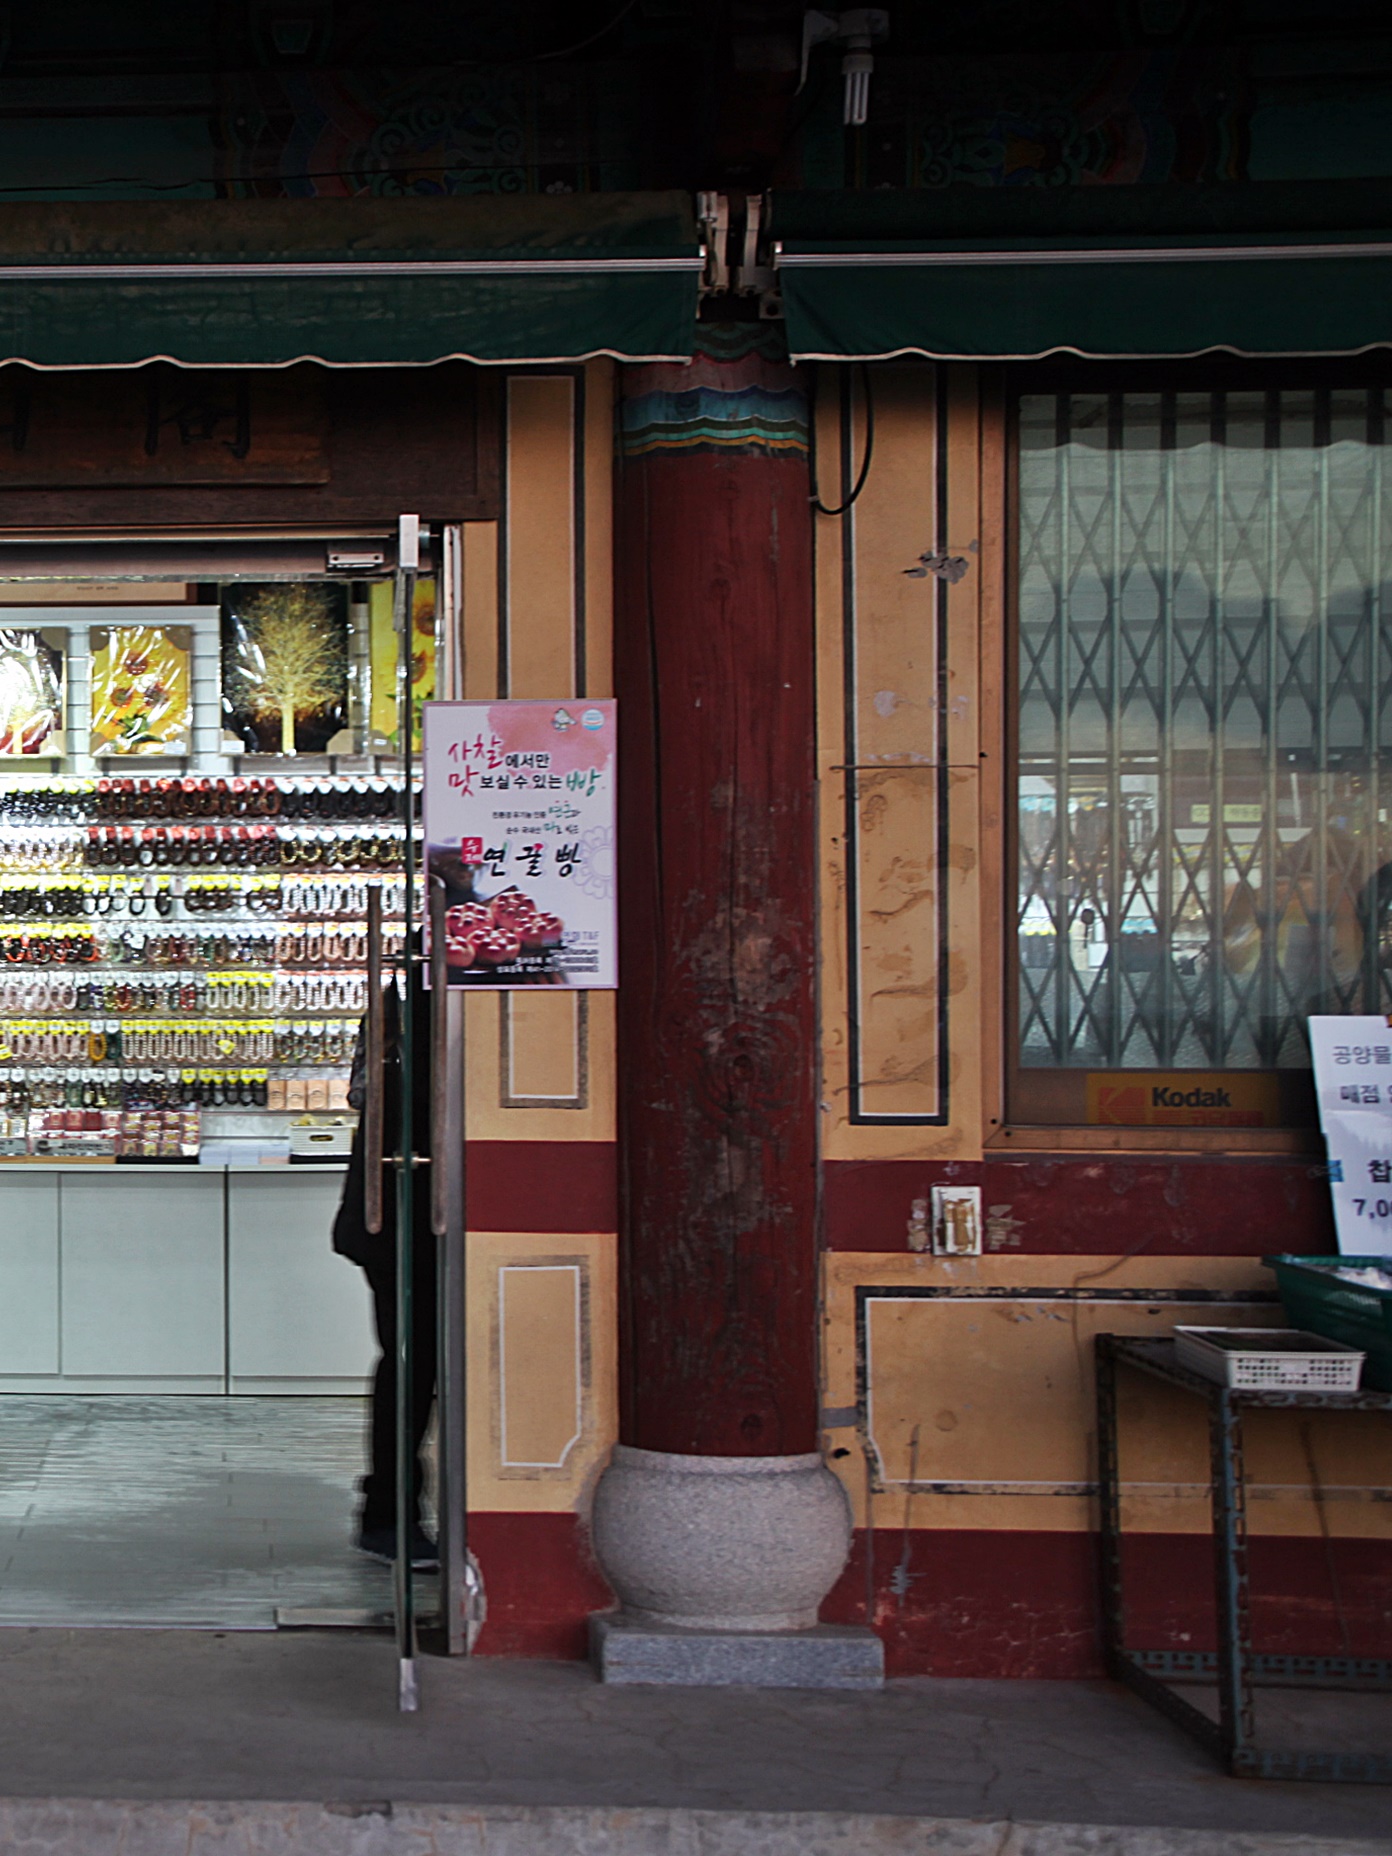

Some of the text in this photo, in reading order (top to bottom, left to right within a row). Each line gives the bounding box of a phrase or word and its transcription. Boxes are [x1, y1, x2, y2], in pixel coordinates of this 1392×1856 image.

[448, 733, 550, 769] 사찰에서만
[532, 775, 562, 789] 있는
[1152, 1086, 1233, 1107] Kodak
[1352, 1198, 1392, 1220] 7,0
